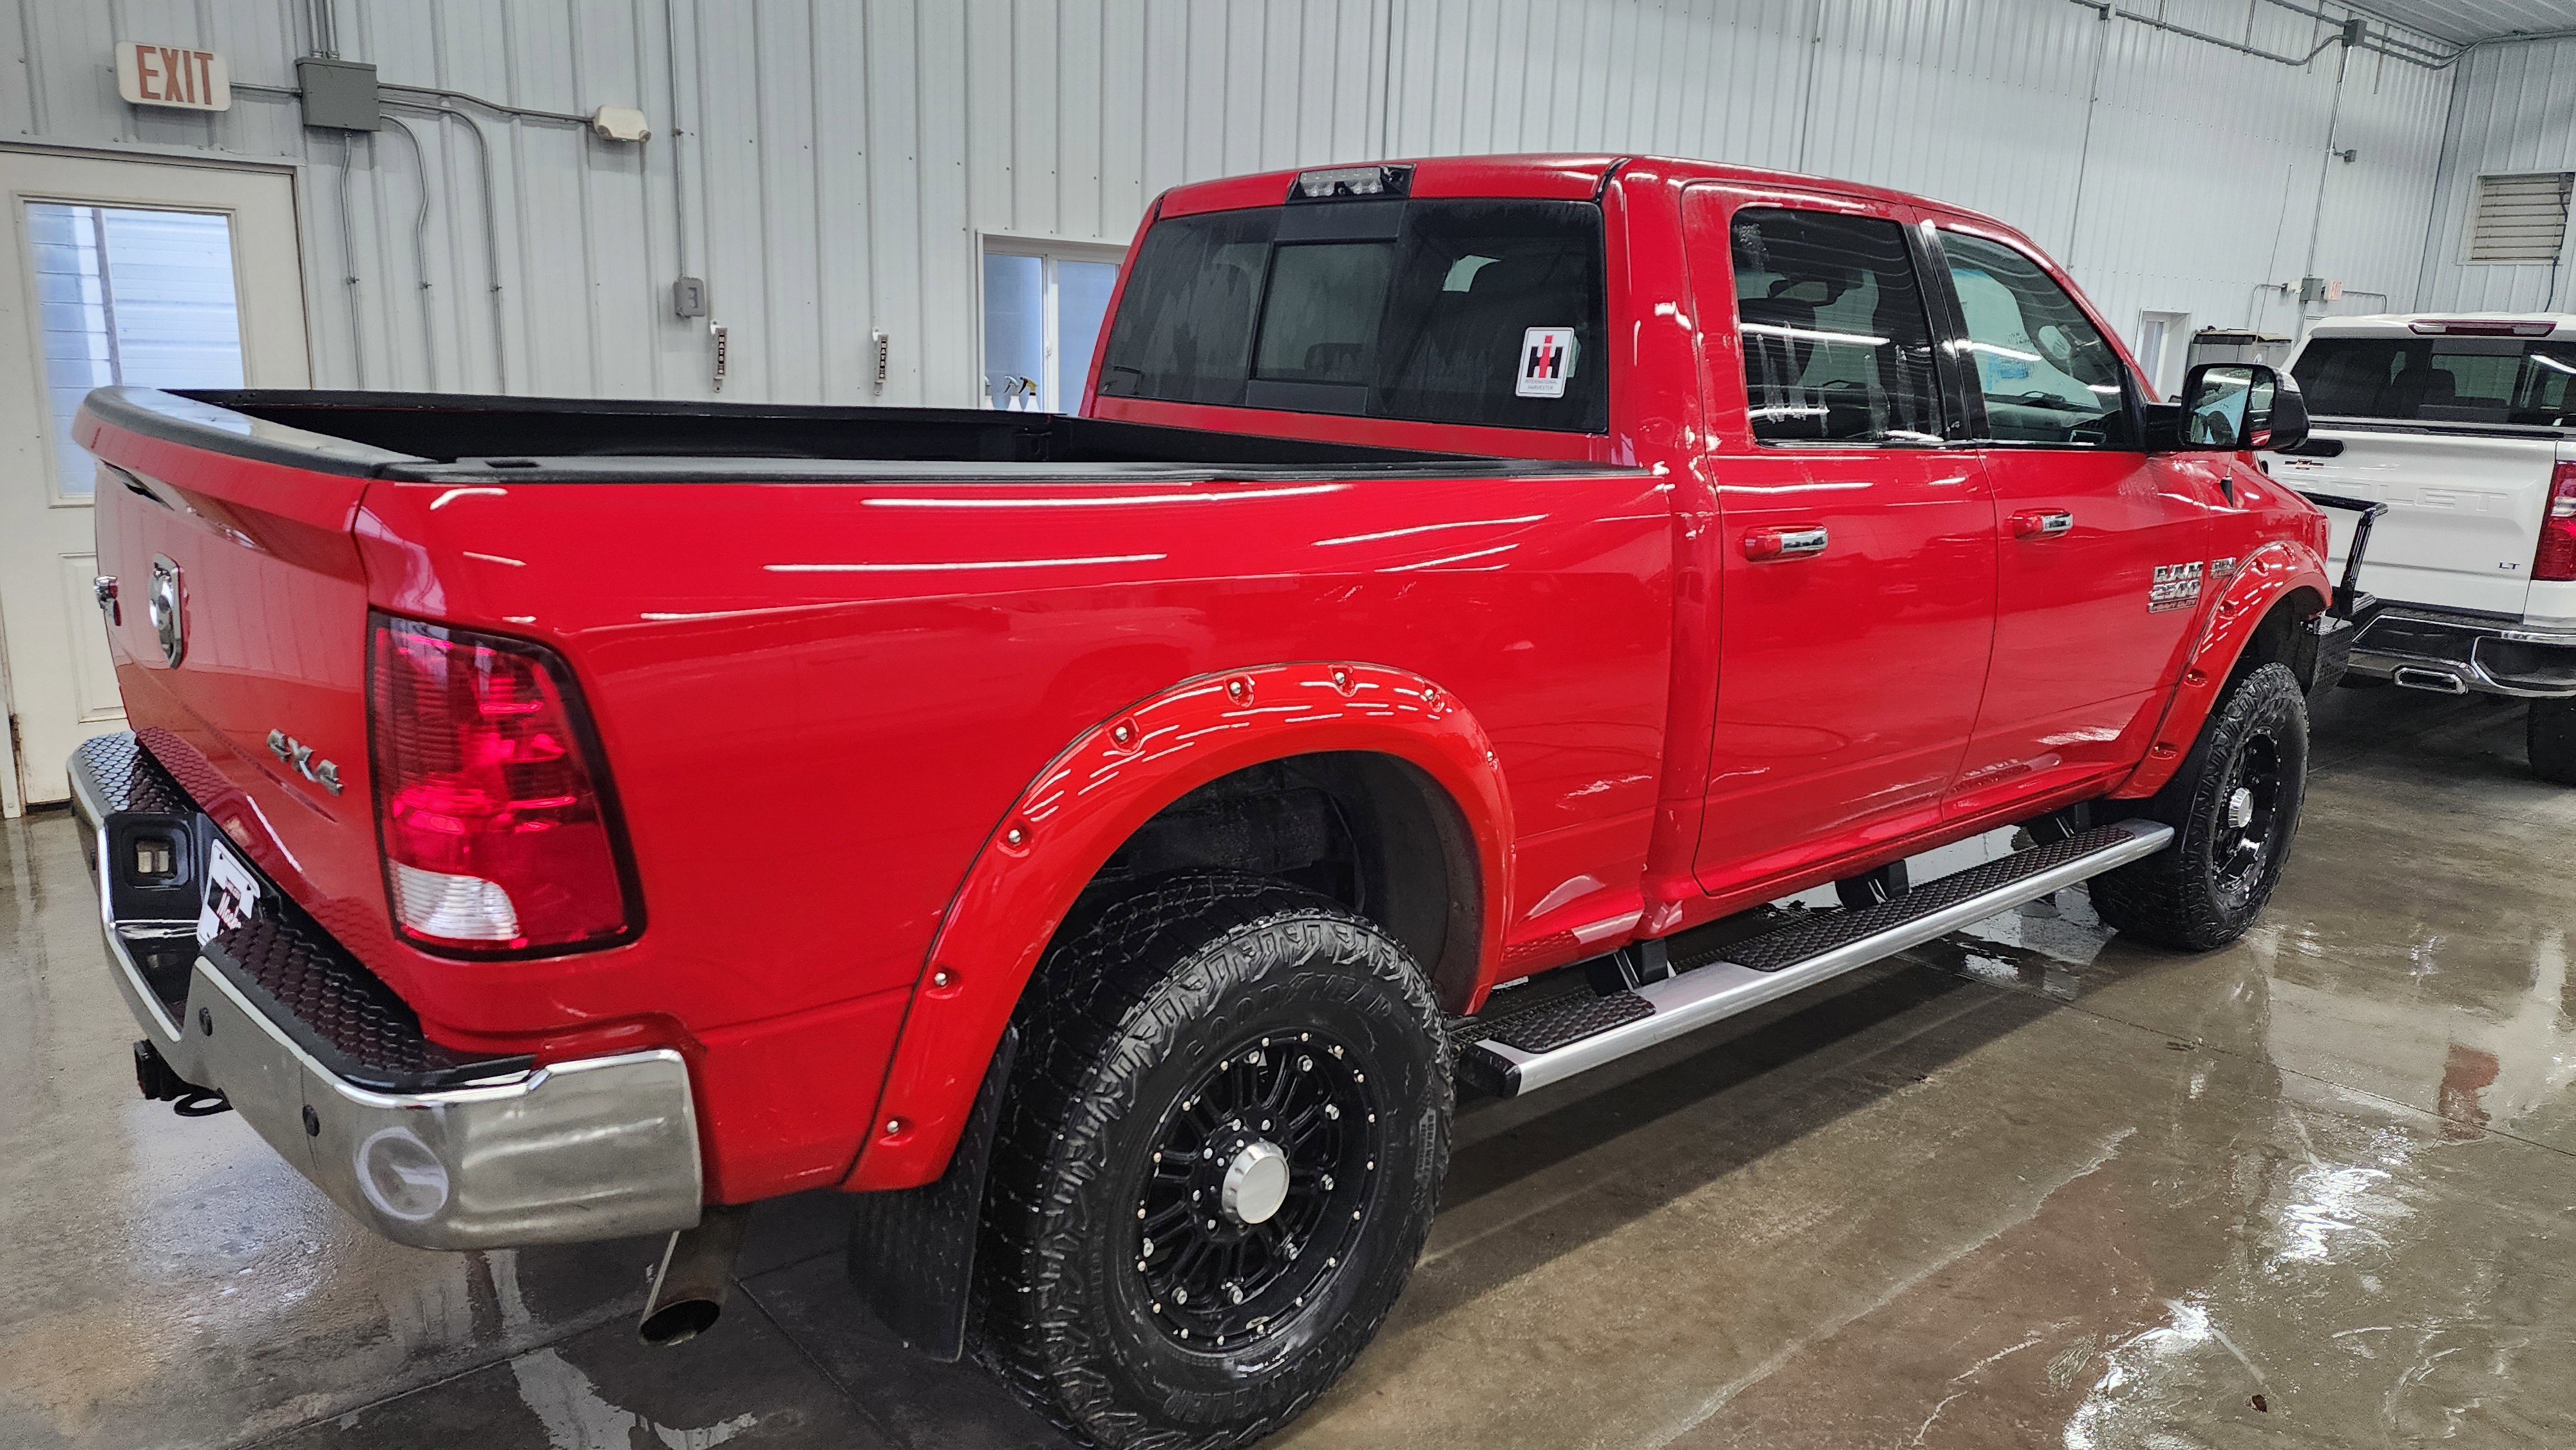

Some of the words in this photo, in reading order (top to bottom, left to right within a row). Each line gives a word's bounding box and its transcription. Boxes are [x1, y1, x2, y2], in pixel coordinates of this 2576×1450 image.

[135, 44, 214, 106] EXIT
[2153, 561, 2204, 583] RAM
[2499, 561, 2521, 570] LT
[2148, 579, 2201, 600] 2500
